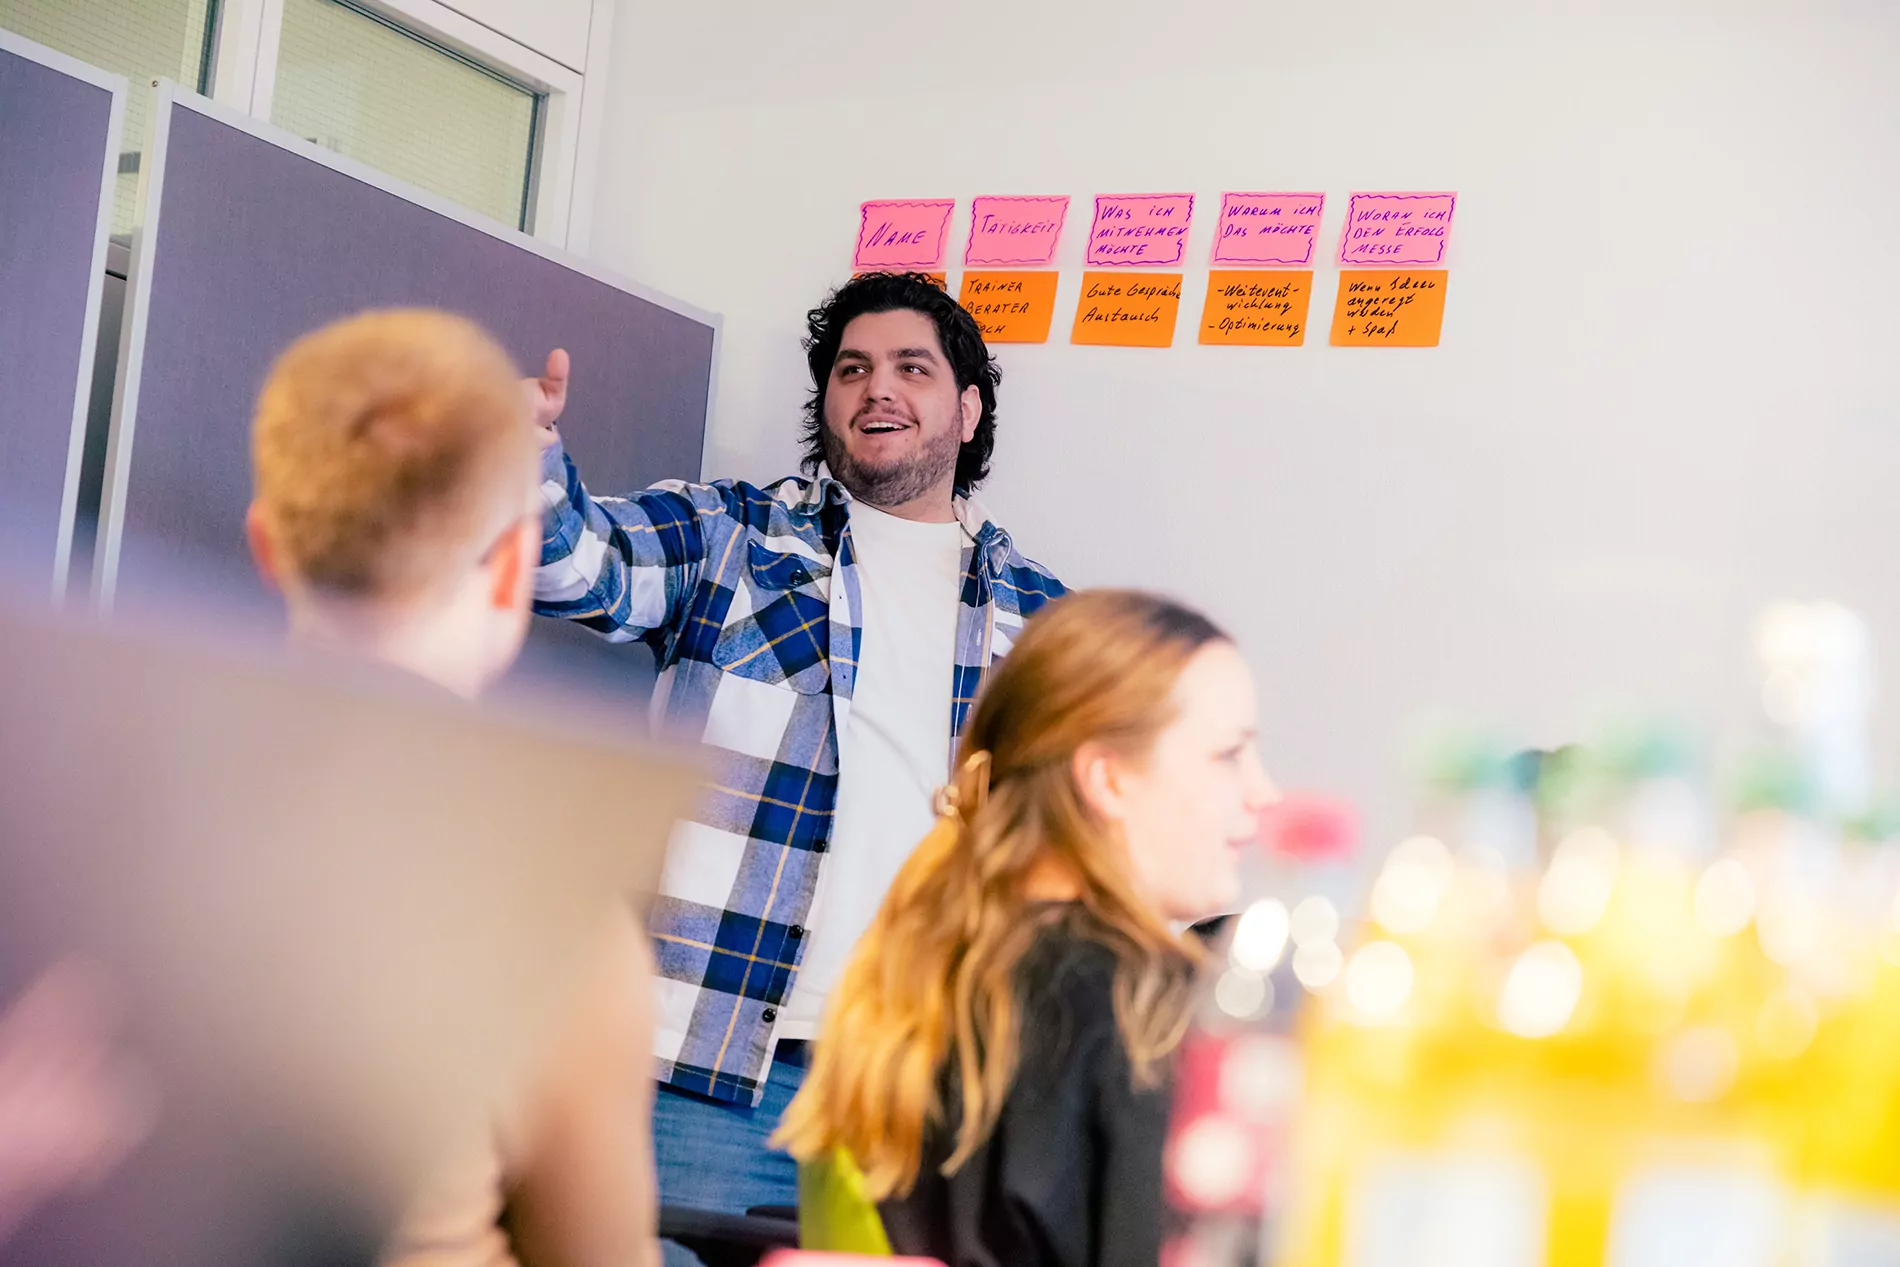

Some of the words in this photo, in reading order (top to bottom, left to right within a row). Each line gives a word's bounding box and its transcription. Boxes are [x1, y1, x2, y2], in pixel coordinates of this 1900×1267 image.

[1101, 205, 1131, 220] WAS
[1228, 205, 1282, 217] WARUM
[1357, 209, 1413, 222] WORAN
[865, 221, 927, 248] NAME
[1223, 223, 1248, 238] DAS
[1353, 227, 1385, 239] DEN
[1351, 244, 1404, 255] MESSE
[1087, 283, 1121, 298] Gute
[966, 301, 1029, 315] BERATER
[1082, 307, 1160, 322] Austausch
